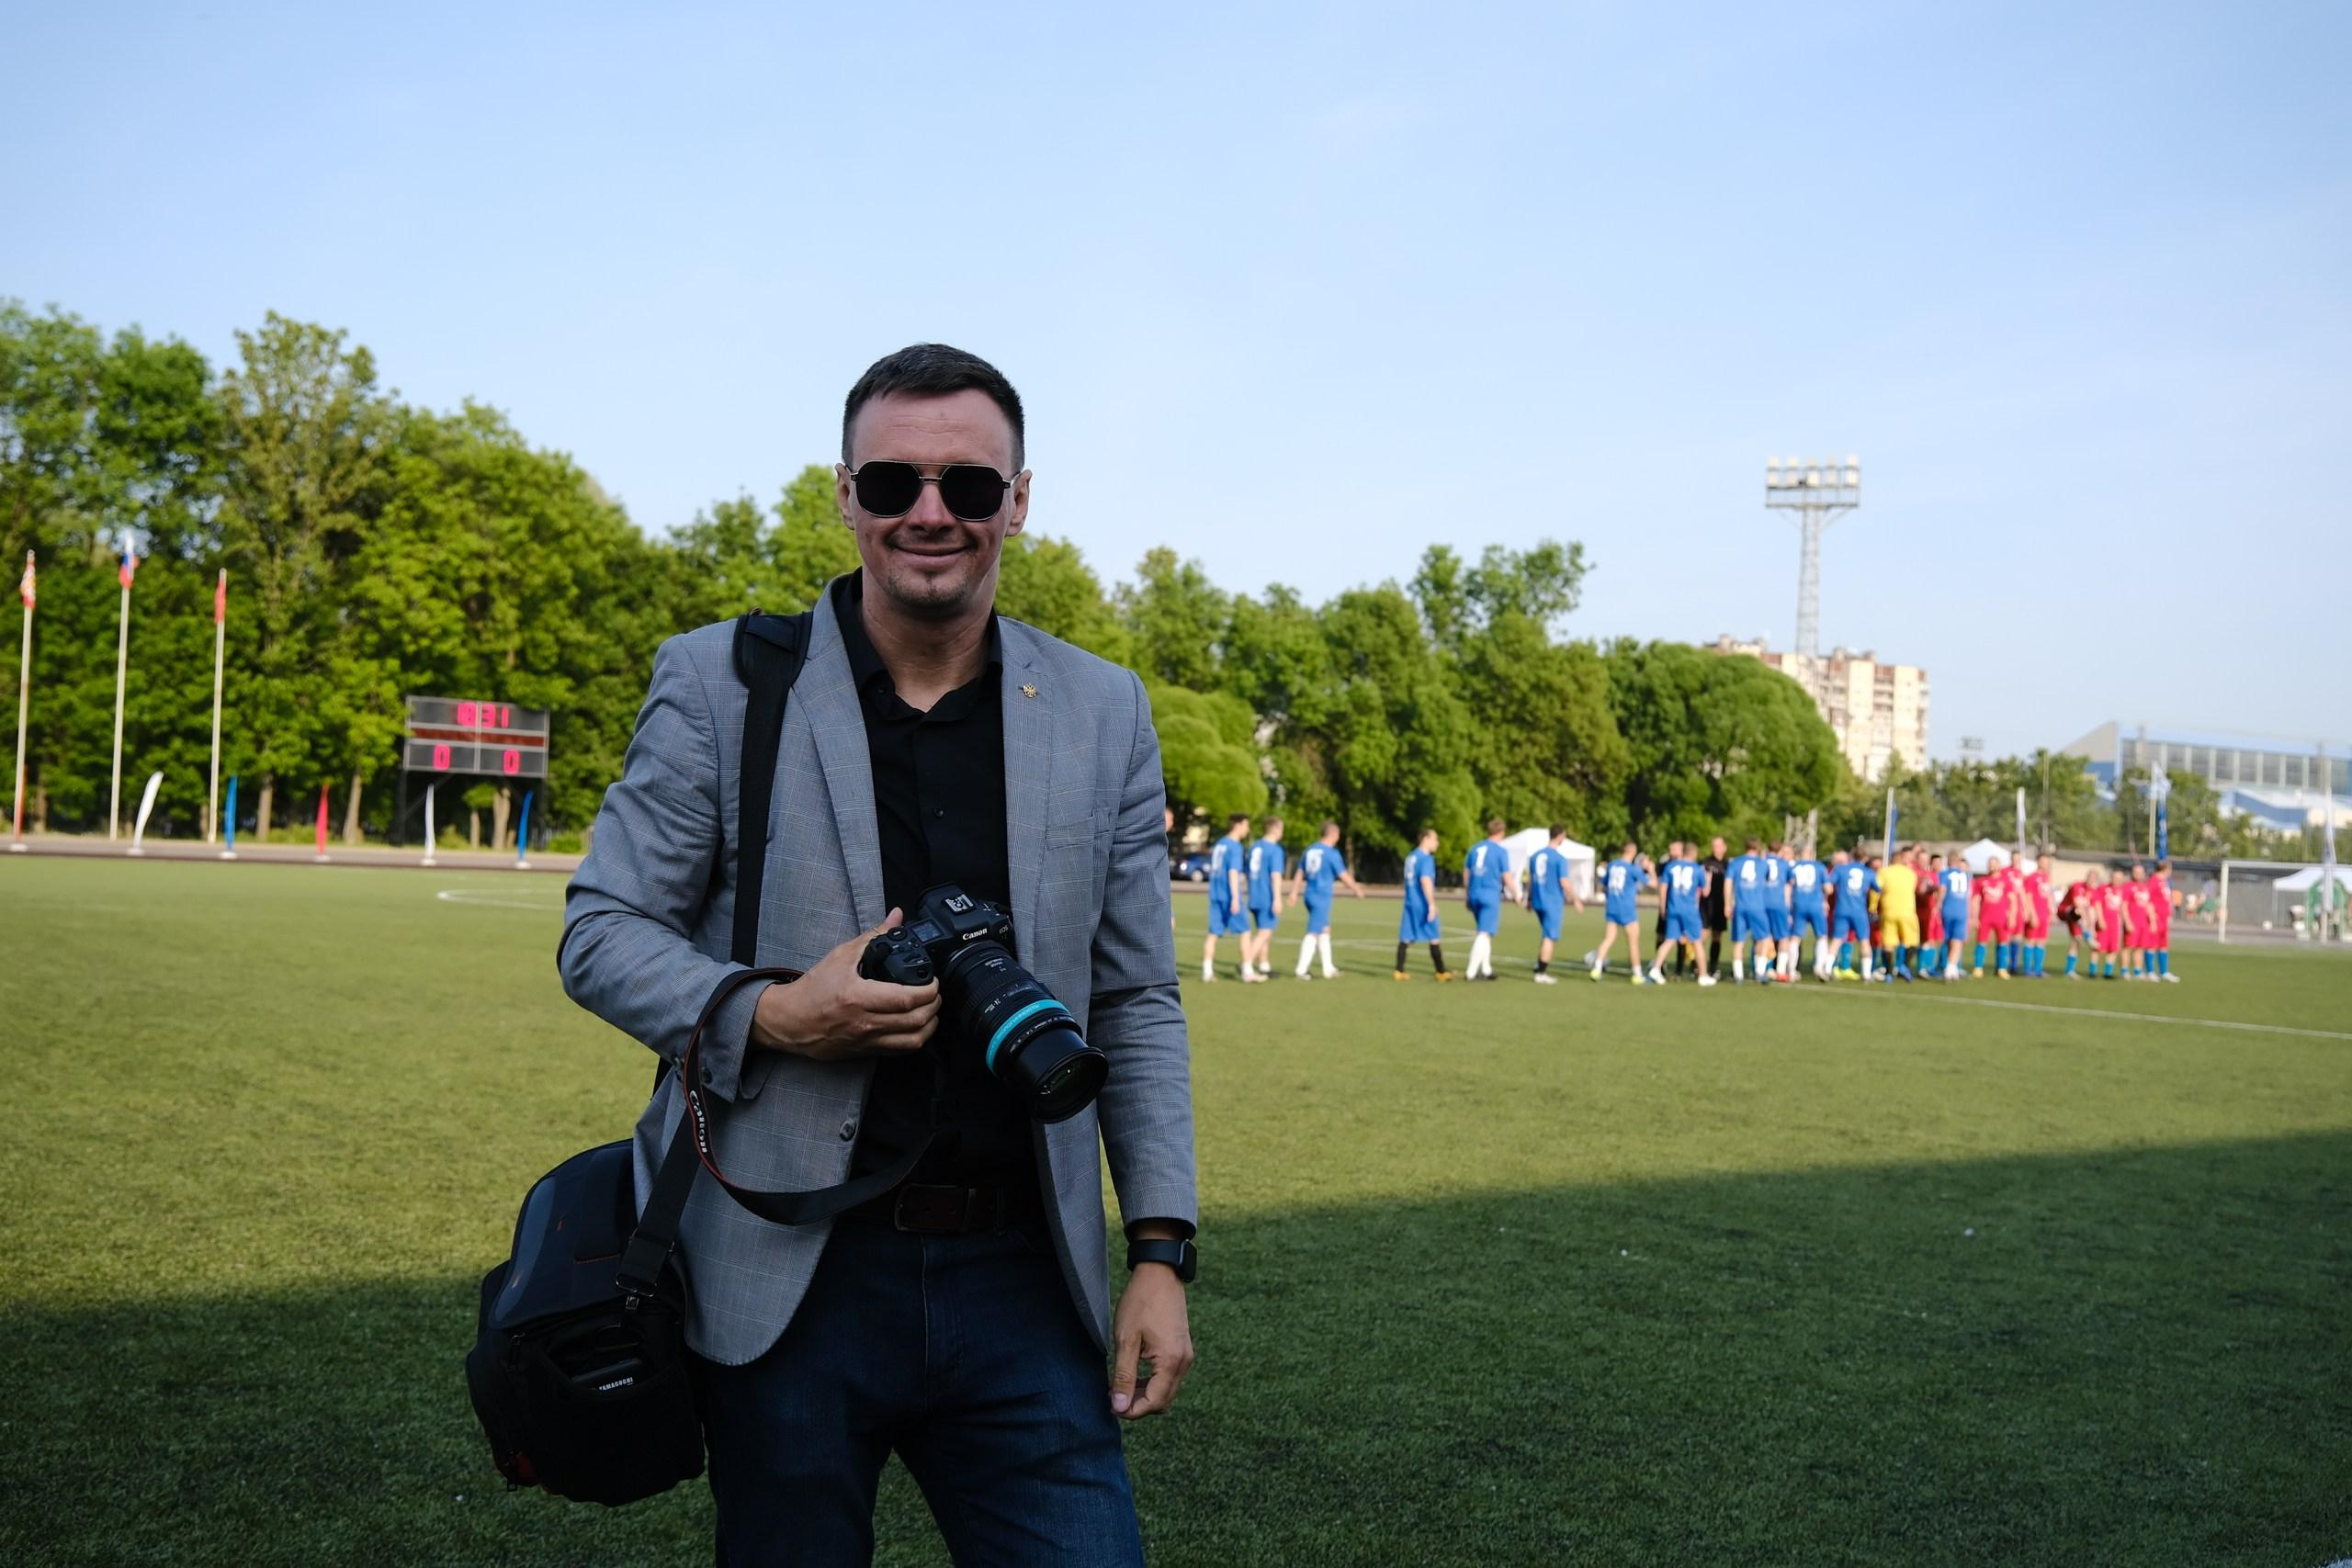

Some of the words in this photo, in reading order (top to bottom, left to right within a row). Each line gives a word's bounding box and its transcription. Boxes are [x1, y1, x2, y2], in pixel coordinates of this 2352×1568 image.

[434, 744, 451, 771] 0
[503, 749, 520, 775] 0
[1476, 845, 1488, 868] 1
[1669, 864, 1694, 890] 14
[1740, 860, 1757, 883] 4
[1848, 867, 1864, 890] 3
[1948, 872, 1968, 893] 11
[962, 928, 988, 941] Canon
[690, 1089, 707, 1153] Canon
